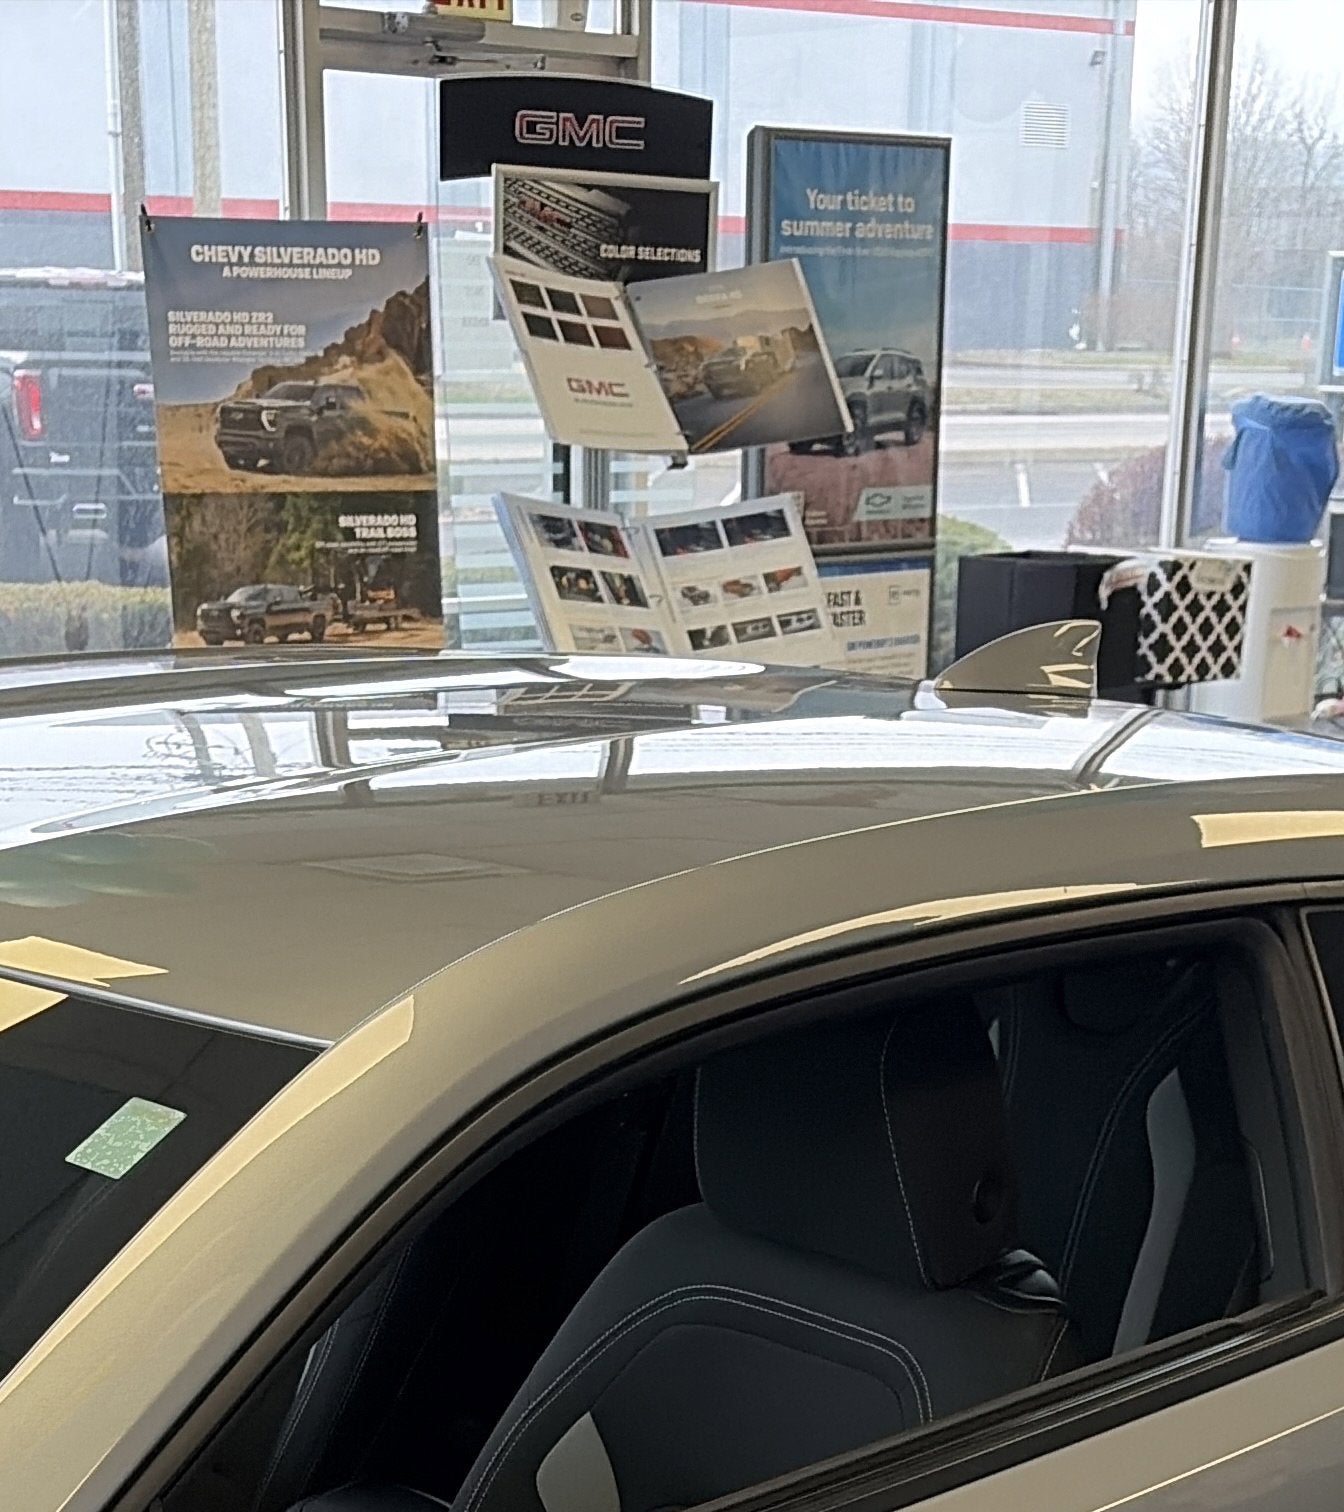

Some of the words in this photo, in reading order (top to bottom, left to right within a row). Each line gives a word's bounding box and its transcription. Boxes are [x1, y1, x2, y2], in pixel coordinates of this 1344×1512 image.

[515, 110, 645, 149] GMC
[806, 188, 845, 210] Your
[846, 189, 894, 212] ticket
[897, 194, 915, 213] to
[781, 219, 852, 237] summer
[856, 217, 934, 240] adventure
[191, 244, 255, 263] CHEVY
[255, 246, 353, 265] SILVERADO
[355, 248, 381, 266] HD
[599, 244, 636, 259] COLOR
[638, 246, 701, 263] SELECTIONS
[223, 267, 232, 278] A
[232, 267, 312, 279] POWERHOUSE
[313, 268, 352, 279] LINEUP
[168, 311, 231, 323] SILVERADO
[233, 312, 250, 323] HD
[251, 312, 273, 323] ZR2
[168, 323, 216, 335] RUGGED
[217, 324, 243, 335] AND
[244, 324, 282, 335] READY
[283, 324, 306, 336] FOR
[168, 336, 228, 348] OFF-ROAD
[229, 336, 305, 348] ADVENTURES
[567, 377, 630, 398] GMC
[338, 514, 399, 527] SILVERADO
[399, 514, 417, 526] HD
[354, 527, 385, 538] TRAIL
[826, 590, 851, 607] FAST
